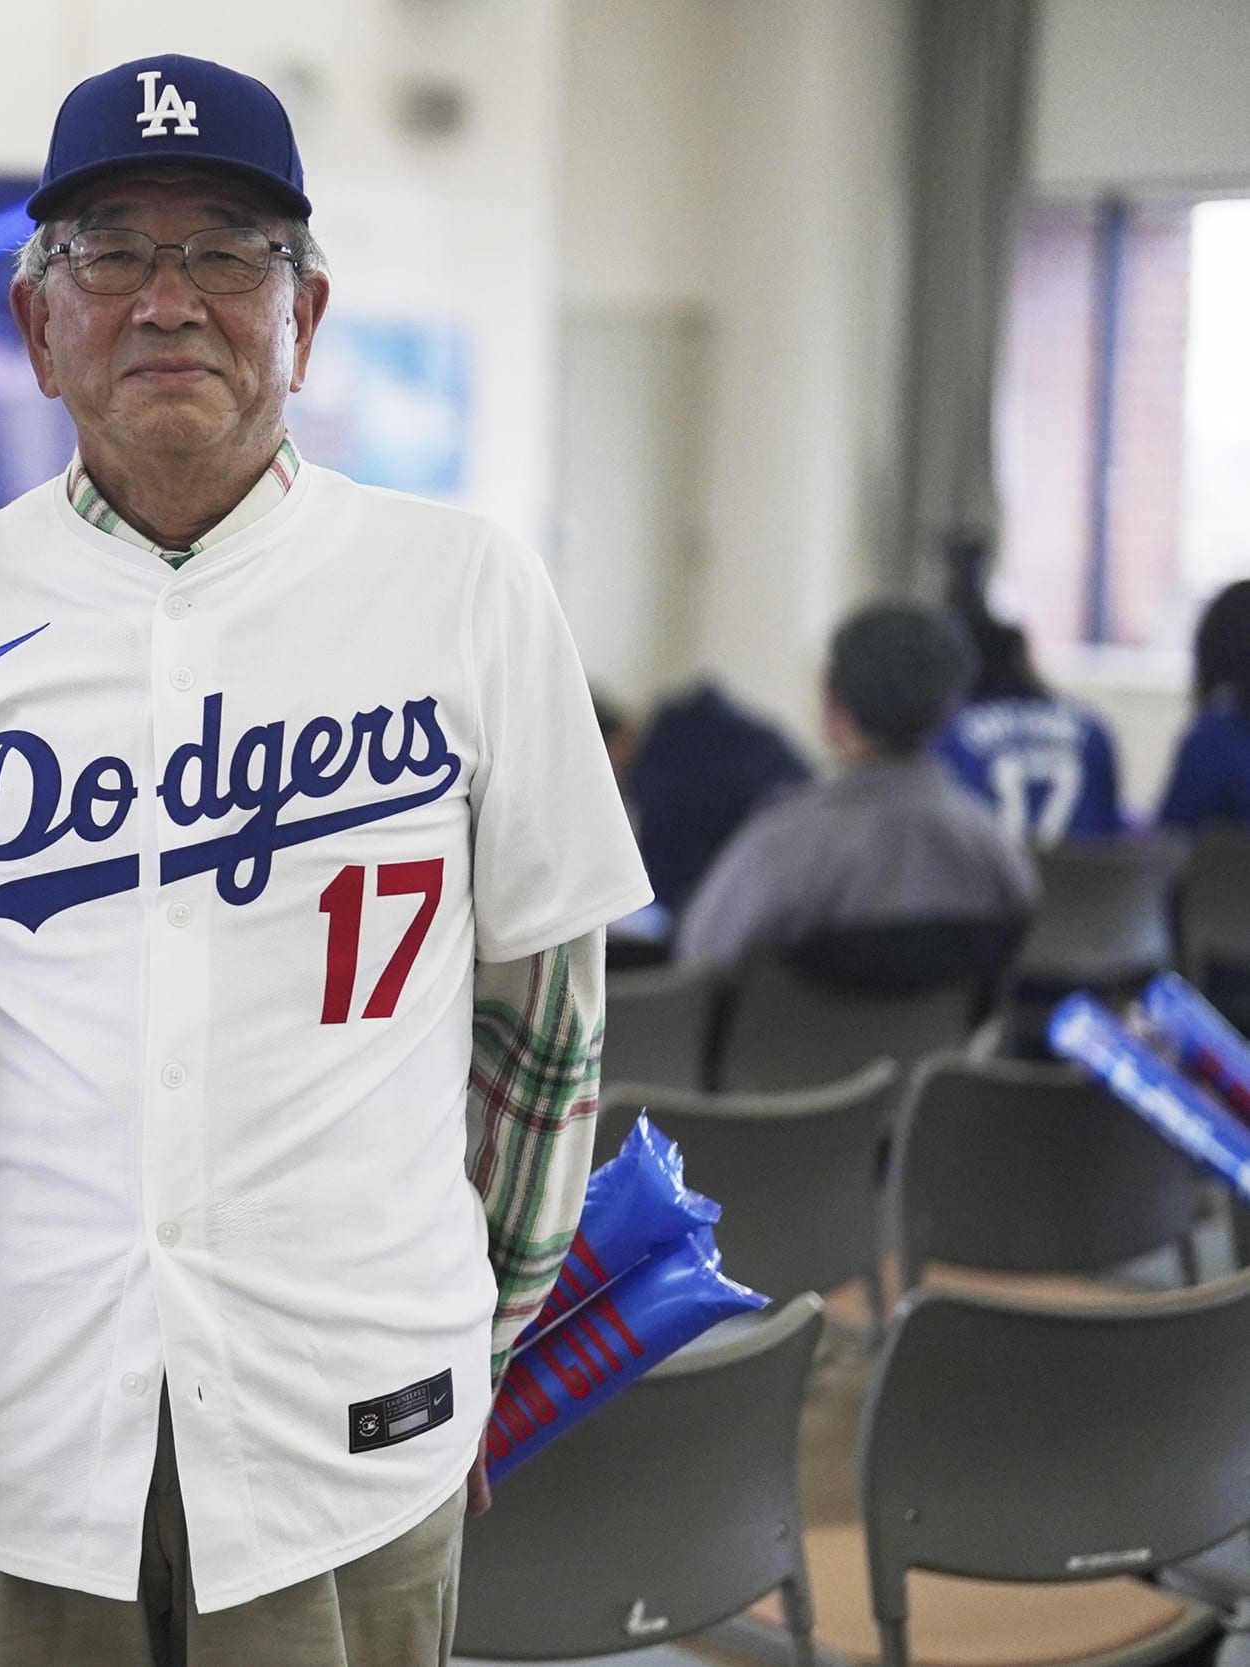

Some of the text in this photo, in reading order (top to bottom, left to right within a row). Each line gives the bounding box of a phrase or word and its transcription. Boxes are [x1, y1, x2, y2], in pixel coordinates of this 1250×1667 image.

[136, 70, 199, 138] LA
[990, 751, 1084, 852] 17
[319, 857, 444, 1025] 17
